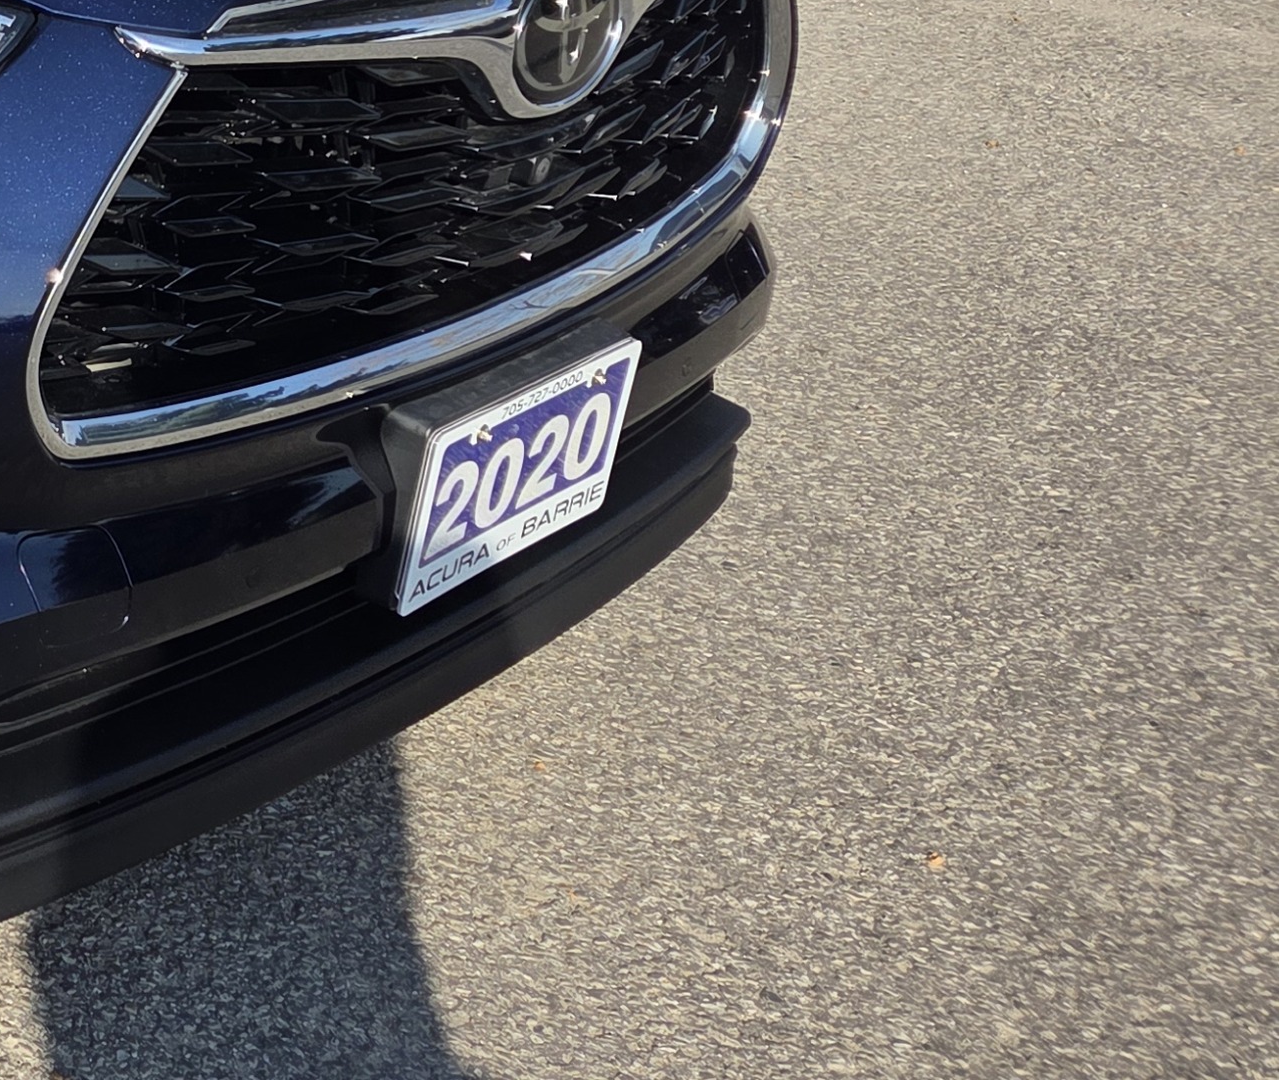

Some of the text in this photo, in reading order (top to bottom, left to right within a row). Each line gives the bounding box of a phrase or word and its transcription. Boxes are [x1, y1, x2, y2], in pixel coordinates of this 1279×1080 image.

[502, 370, 584, 420] 705-727-0000
[423, 392, 612, 560] 2020
[408, 480, 605, 604] ACURA OF BARRIE
